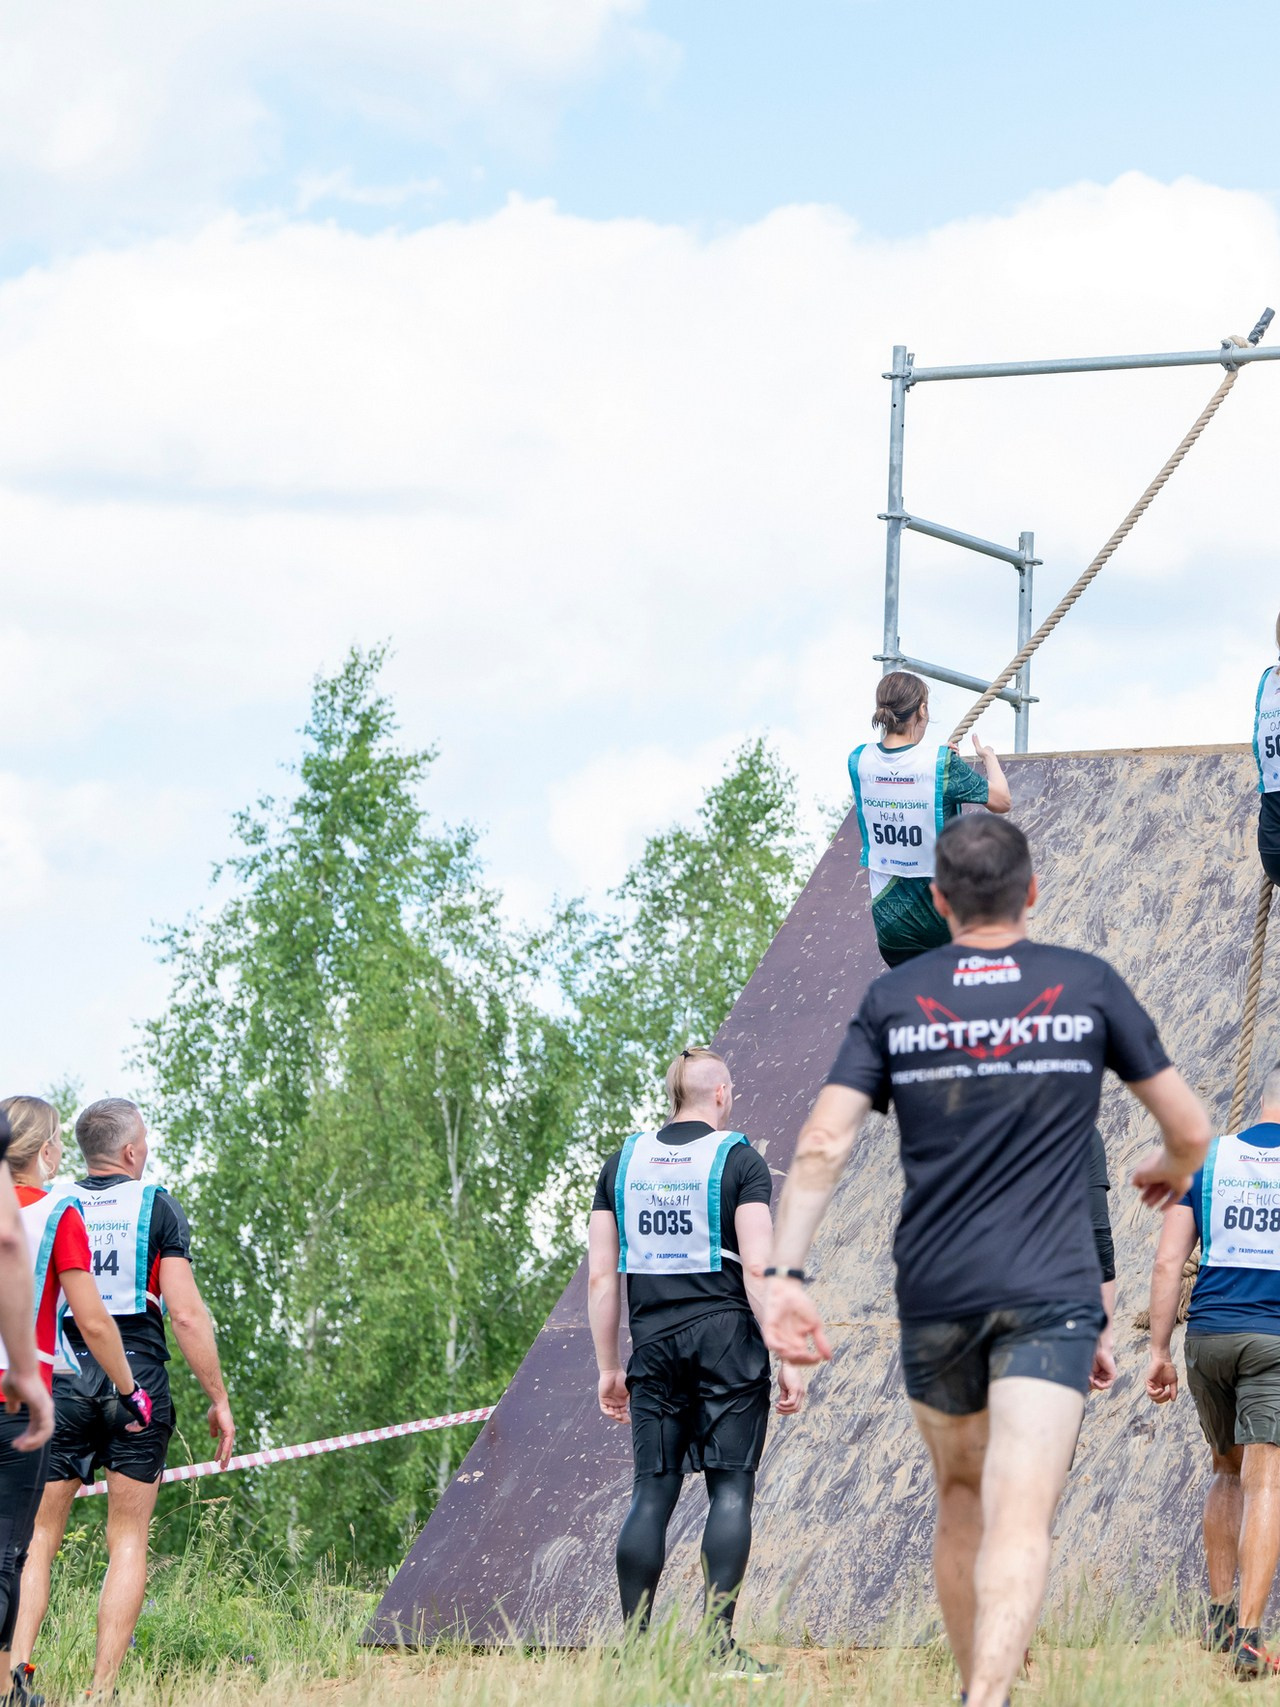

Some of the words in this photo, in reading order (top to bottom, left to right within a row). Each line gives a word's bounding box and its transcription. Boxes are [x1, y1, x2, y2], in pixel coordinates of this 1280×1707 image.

[864, 798, 929, 810] РОСАГРОЛИЗИНГ
[873, 822, 923, 847] 5040
[890, 859, 919, 867] ГАЗПРОМБАНК
[957, 955, 1016, 970] ГОНКА
[953, 966, 1022, 987] ГЕРОЕВ
[888, 1014, 1094, 1055] ИНСТРУКТОР
[1239, 1154, 1260, 1162] ГОНКА
[630, 1182, 702, 1192] РОСАГРОЛИЗИНГ
[1233, 1190, 1280, 1207] ДЕНИС
[638, 1210, 693, 1235] 6035
[1238, 1247, 1274, 1255] ГАЗПРОМБАНК
[93, 1250, 119, 1276] 44
